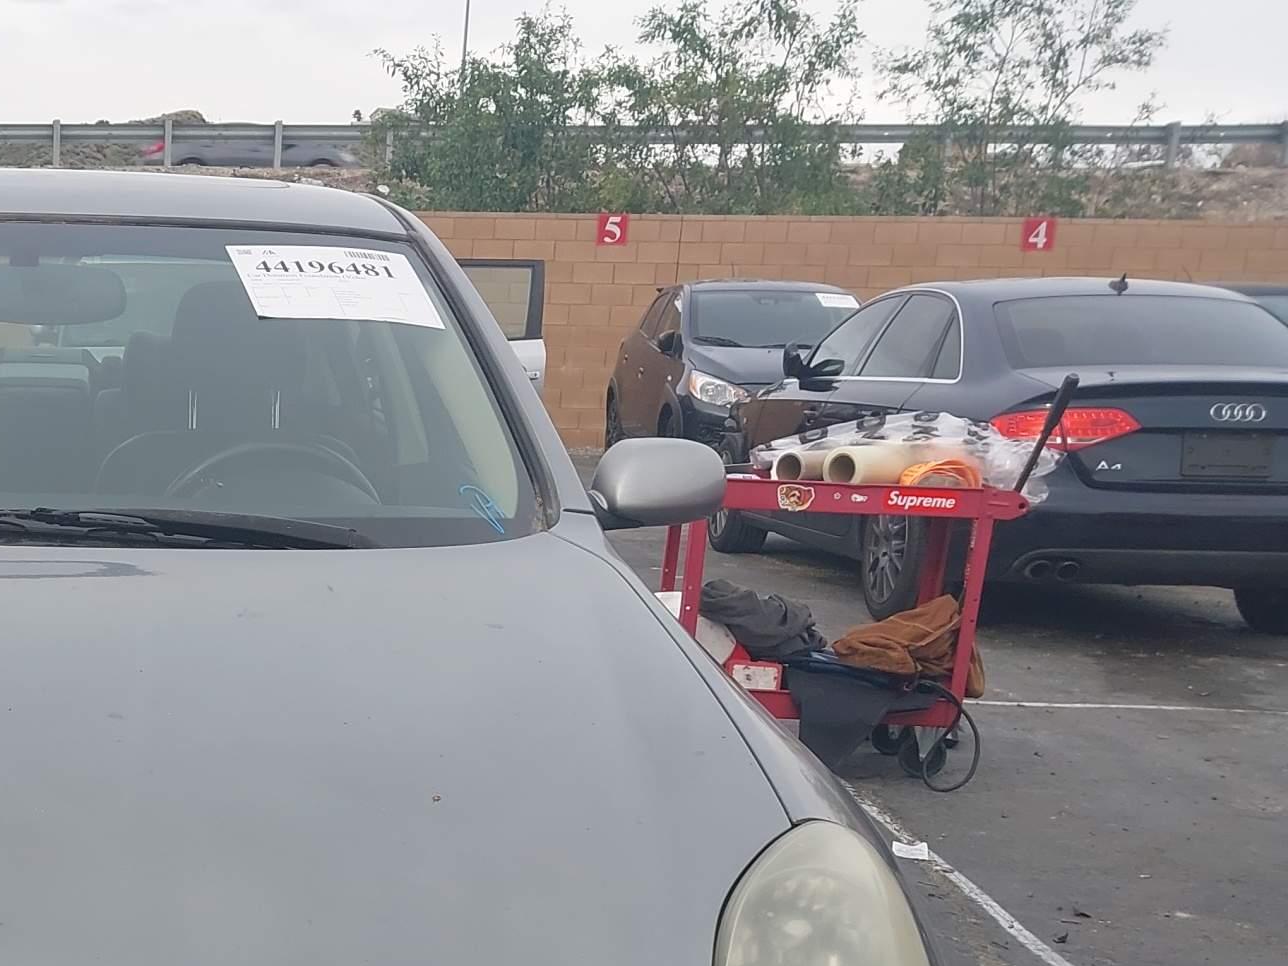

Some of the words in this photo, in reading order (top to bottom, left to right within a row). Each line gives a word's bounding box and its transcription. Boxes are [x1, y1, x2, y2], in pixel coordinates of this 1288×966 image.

[603, 216, 622, 243] 5
[1028, 221, 1047, 249] 4
[255, 259, 396, 279] 44196481
[1096, 460, 1122, 471] A4
[887, 490, 956, 509] Supreme
